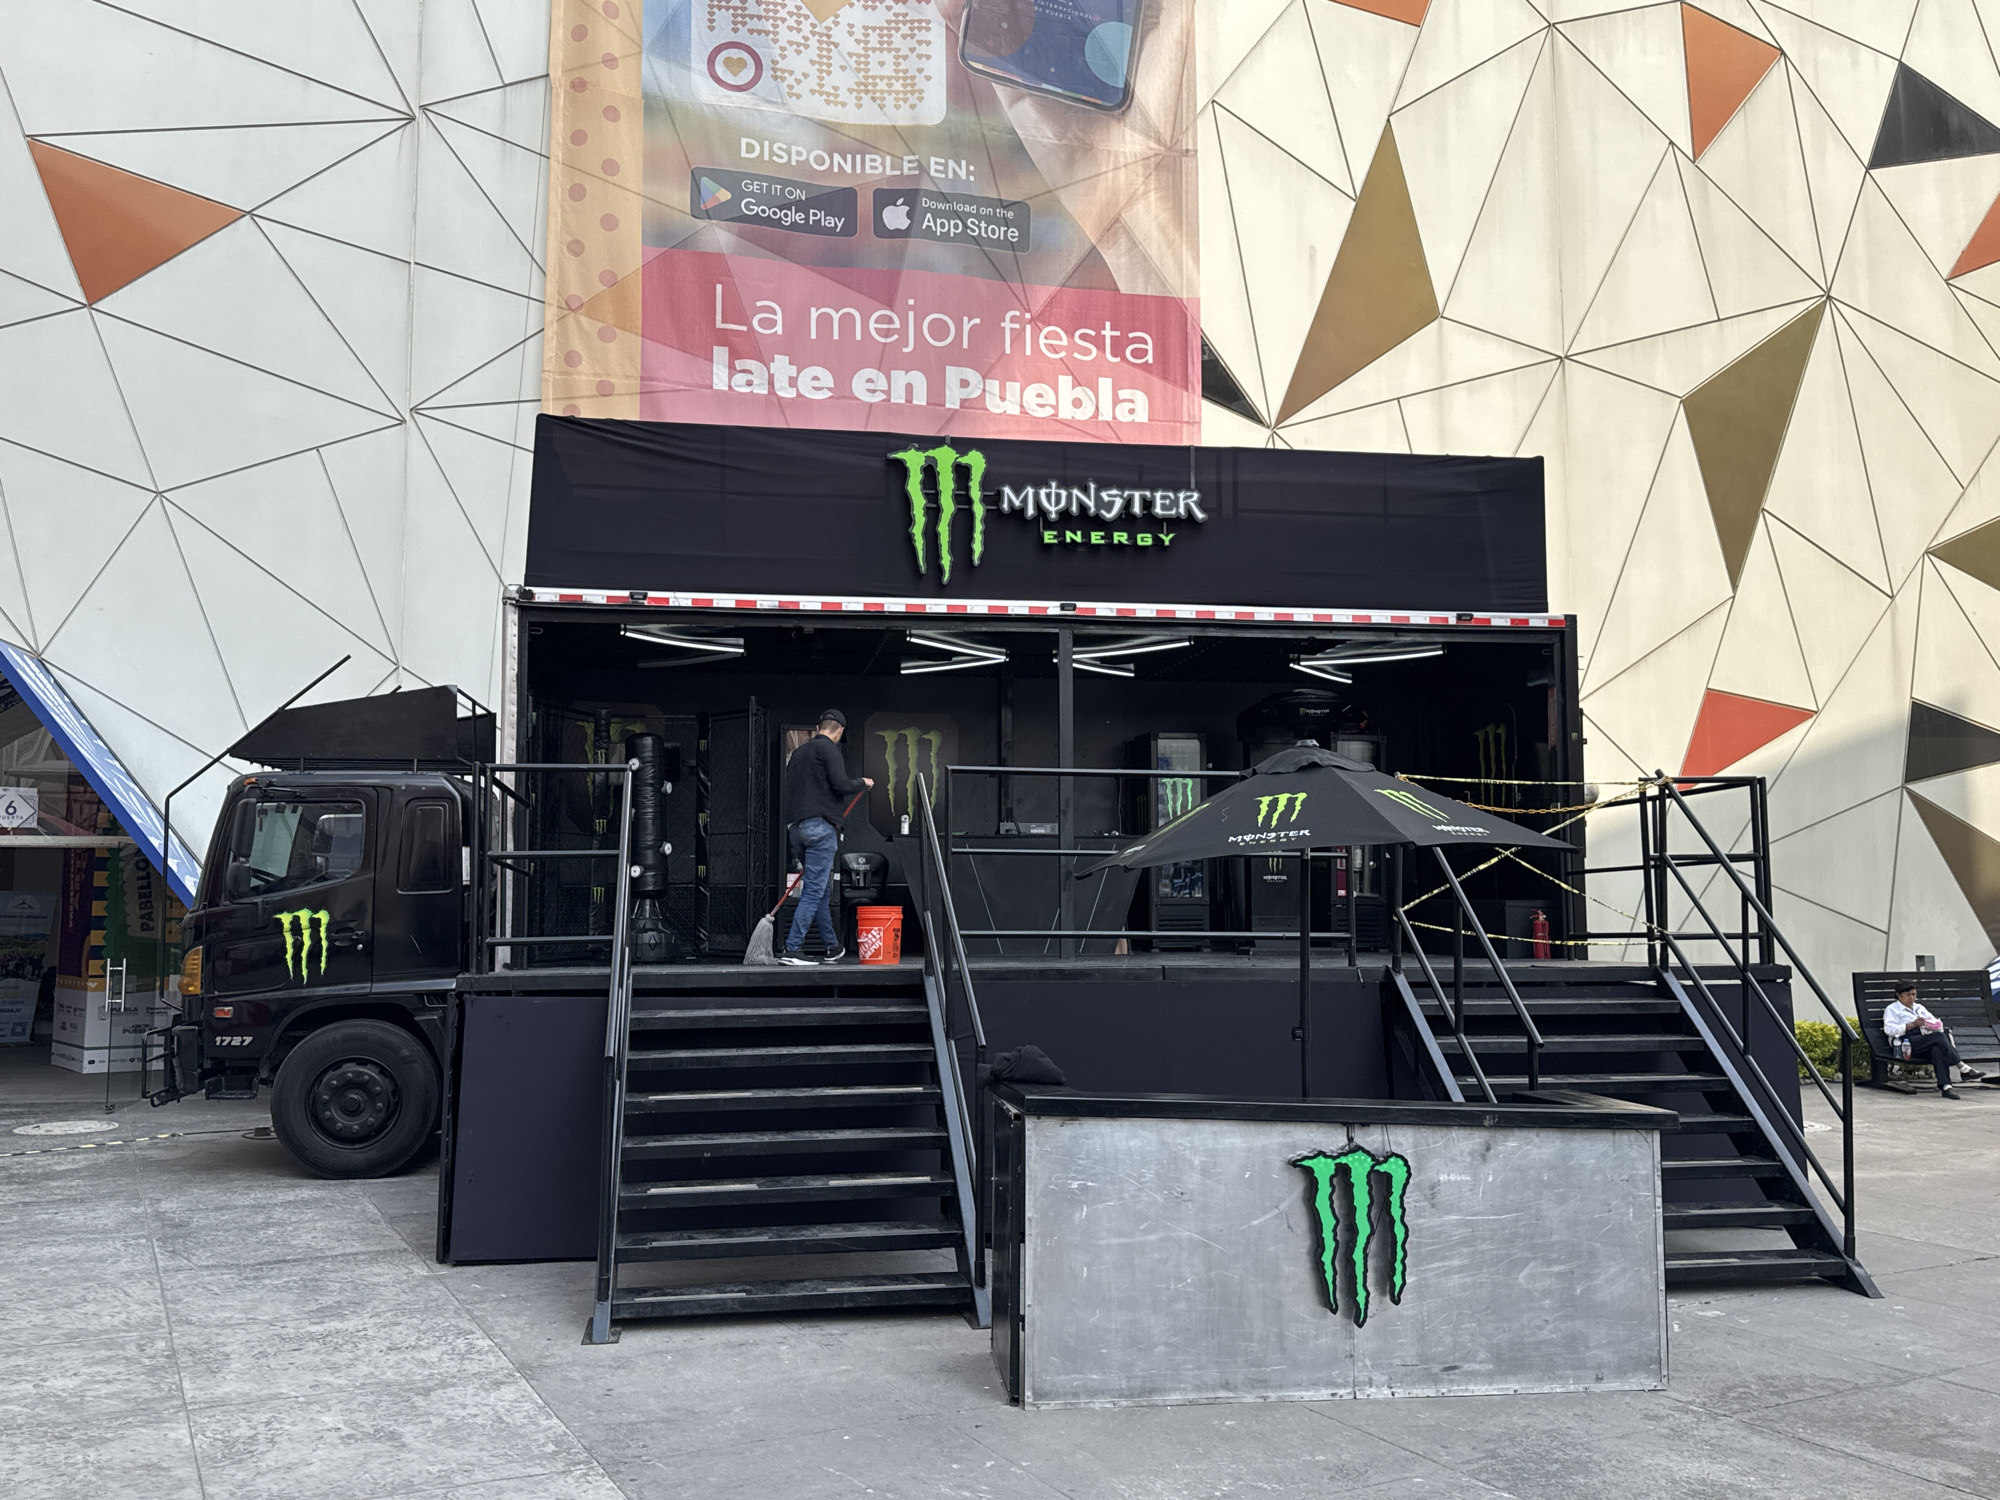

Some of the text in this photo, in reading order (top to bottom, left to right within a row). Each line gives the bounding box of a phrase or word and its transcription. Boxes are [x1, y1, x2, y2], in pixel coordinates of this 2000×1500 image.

[1037, 0, 1093, 20] INTERNACIONAL
[1045, 9, 1072, 20] PUEBLA
[740, 137, 975, 182] DISPONIBLE EN:
[741, 179, 806, 201] GET IT ON
[741, 198, 845, 233] Google Play
[921, 198, 1014, 219] Download on the
[921, 212, 1019, 242] App Store
[715, 283, 1154, 364] La mejor fiesta
[713, 345, 1149, 423] late en Puebla
[1001, 480, 1206, 521] MONSTER
[1043, 530, 1175, 547] ENERGY
[5, 800, 17, 815] 6
[1228, 829, 1311, 843] MONSTER
[1239, 837, 1297, 846] ENERGY
[215, 1036, 253, 1046] 1727
